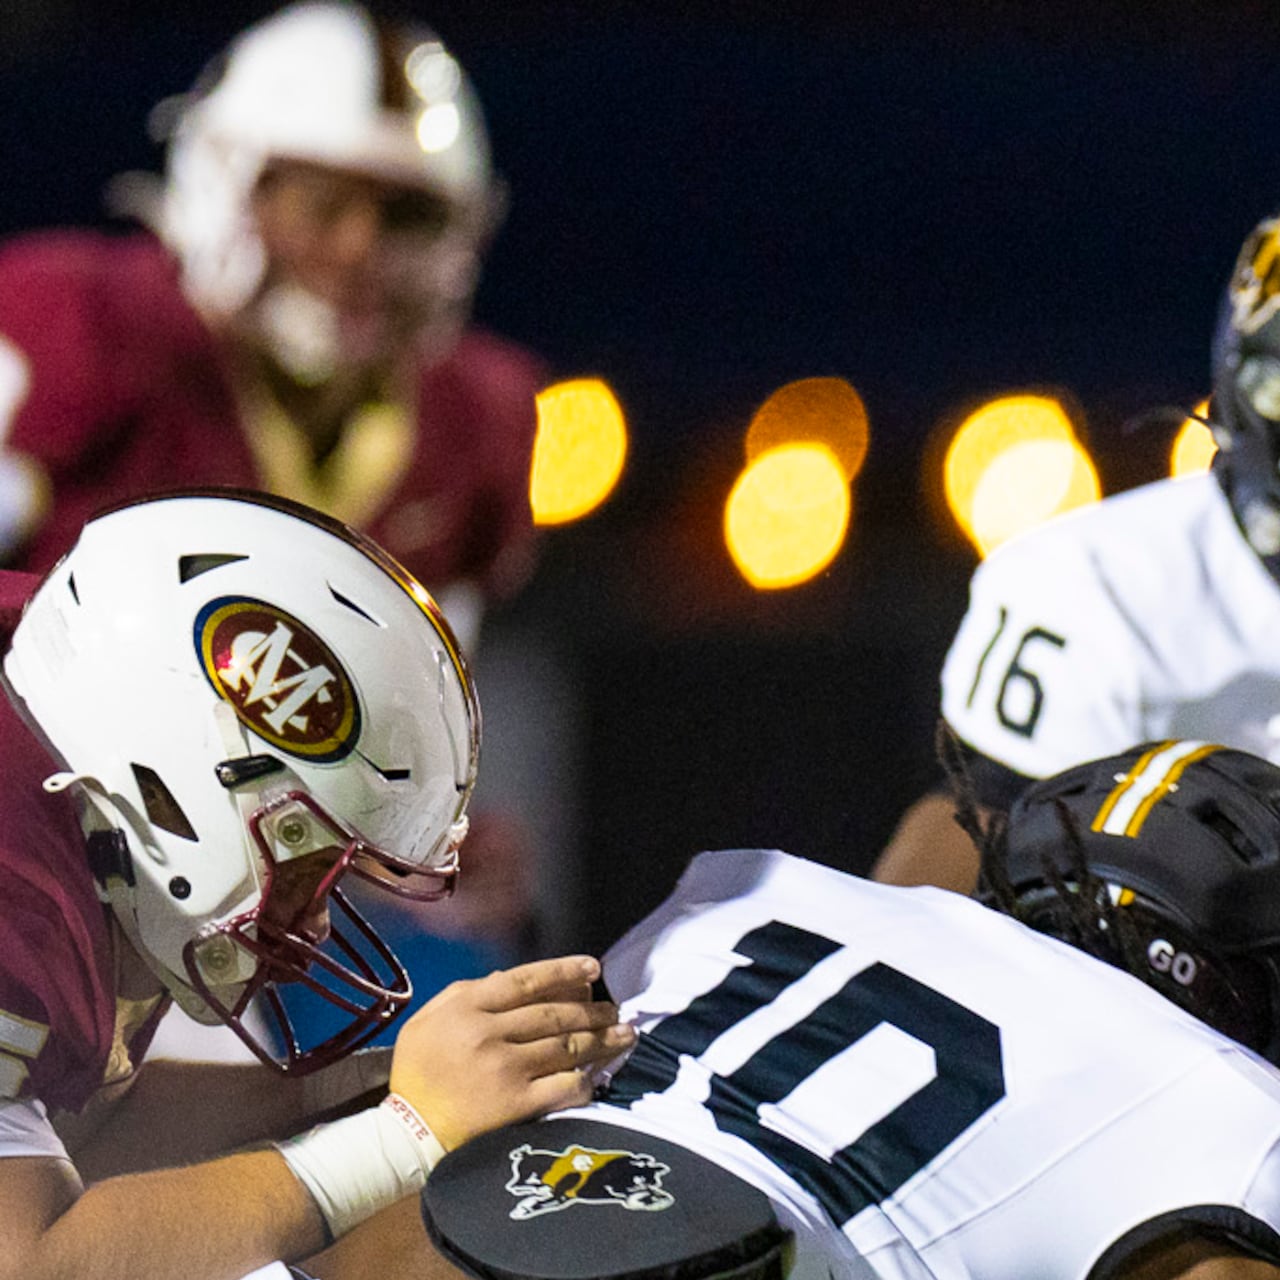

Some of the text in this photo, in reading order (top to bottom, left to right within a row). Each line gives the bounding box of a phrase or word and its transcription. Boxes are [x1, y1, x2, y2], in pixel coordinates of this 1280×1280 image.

[966, 606, 1066, 740] 16
[385, 1095, 430, 1141] MPETE
[592, 919, 1007, 1230] 10
